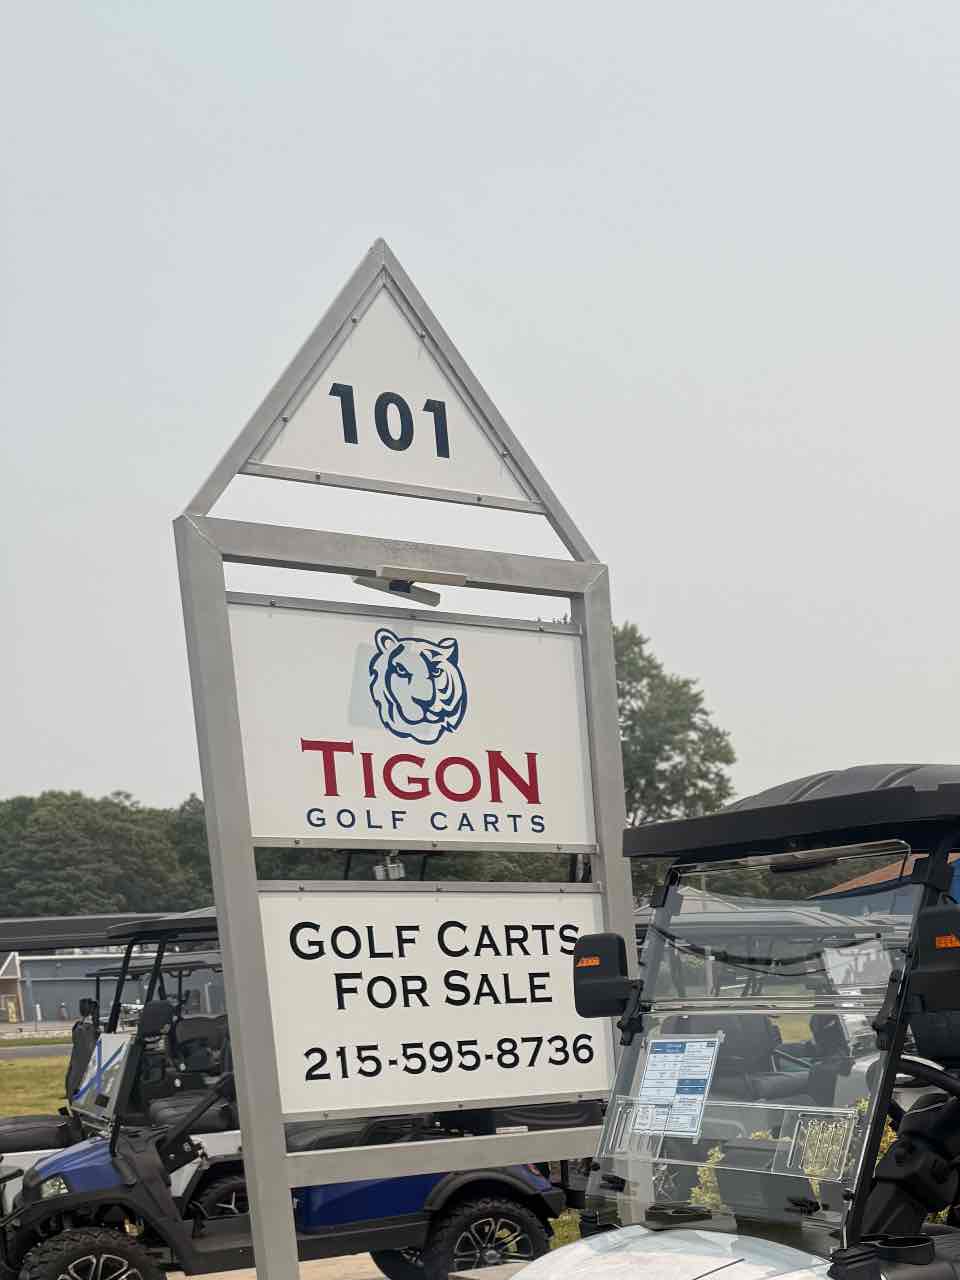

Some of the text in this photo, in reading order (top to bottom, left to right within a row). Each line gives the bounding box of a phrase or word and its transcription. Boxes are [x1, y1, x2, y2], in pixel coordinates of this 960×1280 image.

[328, 382, 450, 459] 101
[301, 738, 542, 805] TIGON
[306, 807, 546, 834] GOLF CARTS
[289, 920, 579, 961] GOLF CARTS
[334, 969, 553, 1011] FOR SALE
[304, 1033, 594, 1082] 215-595-8736
